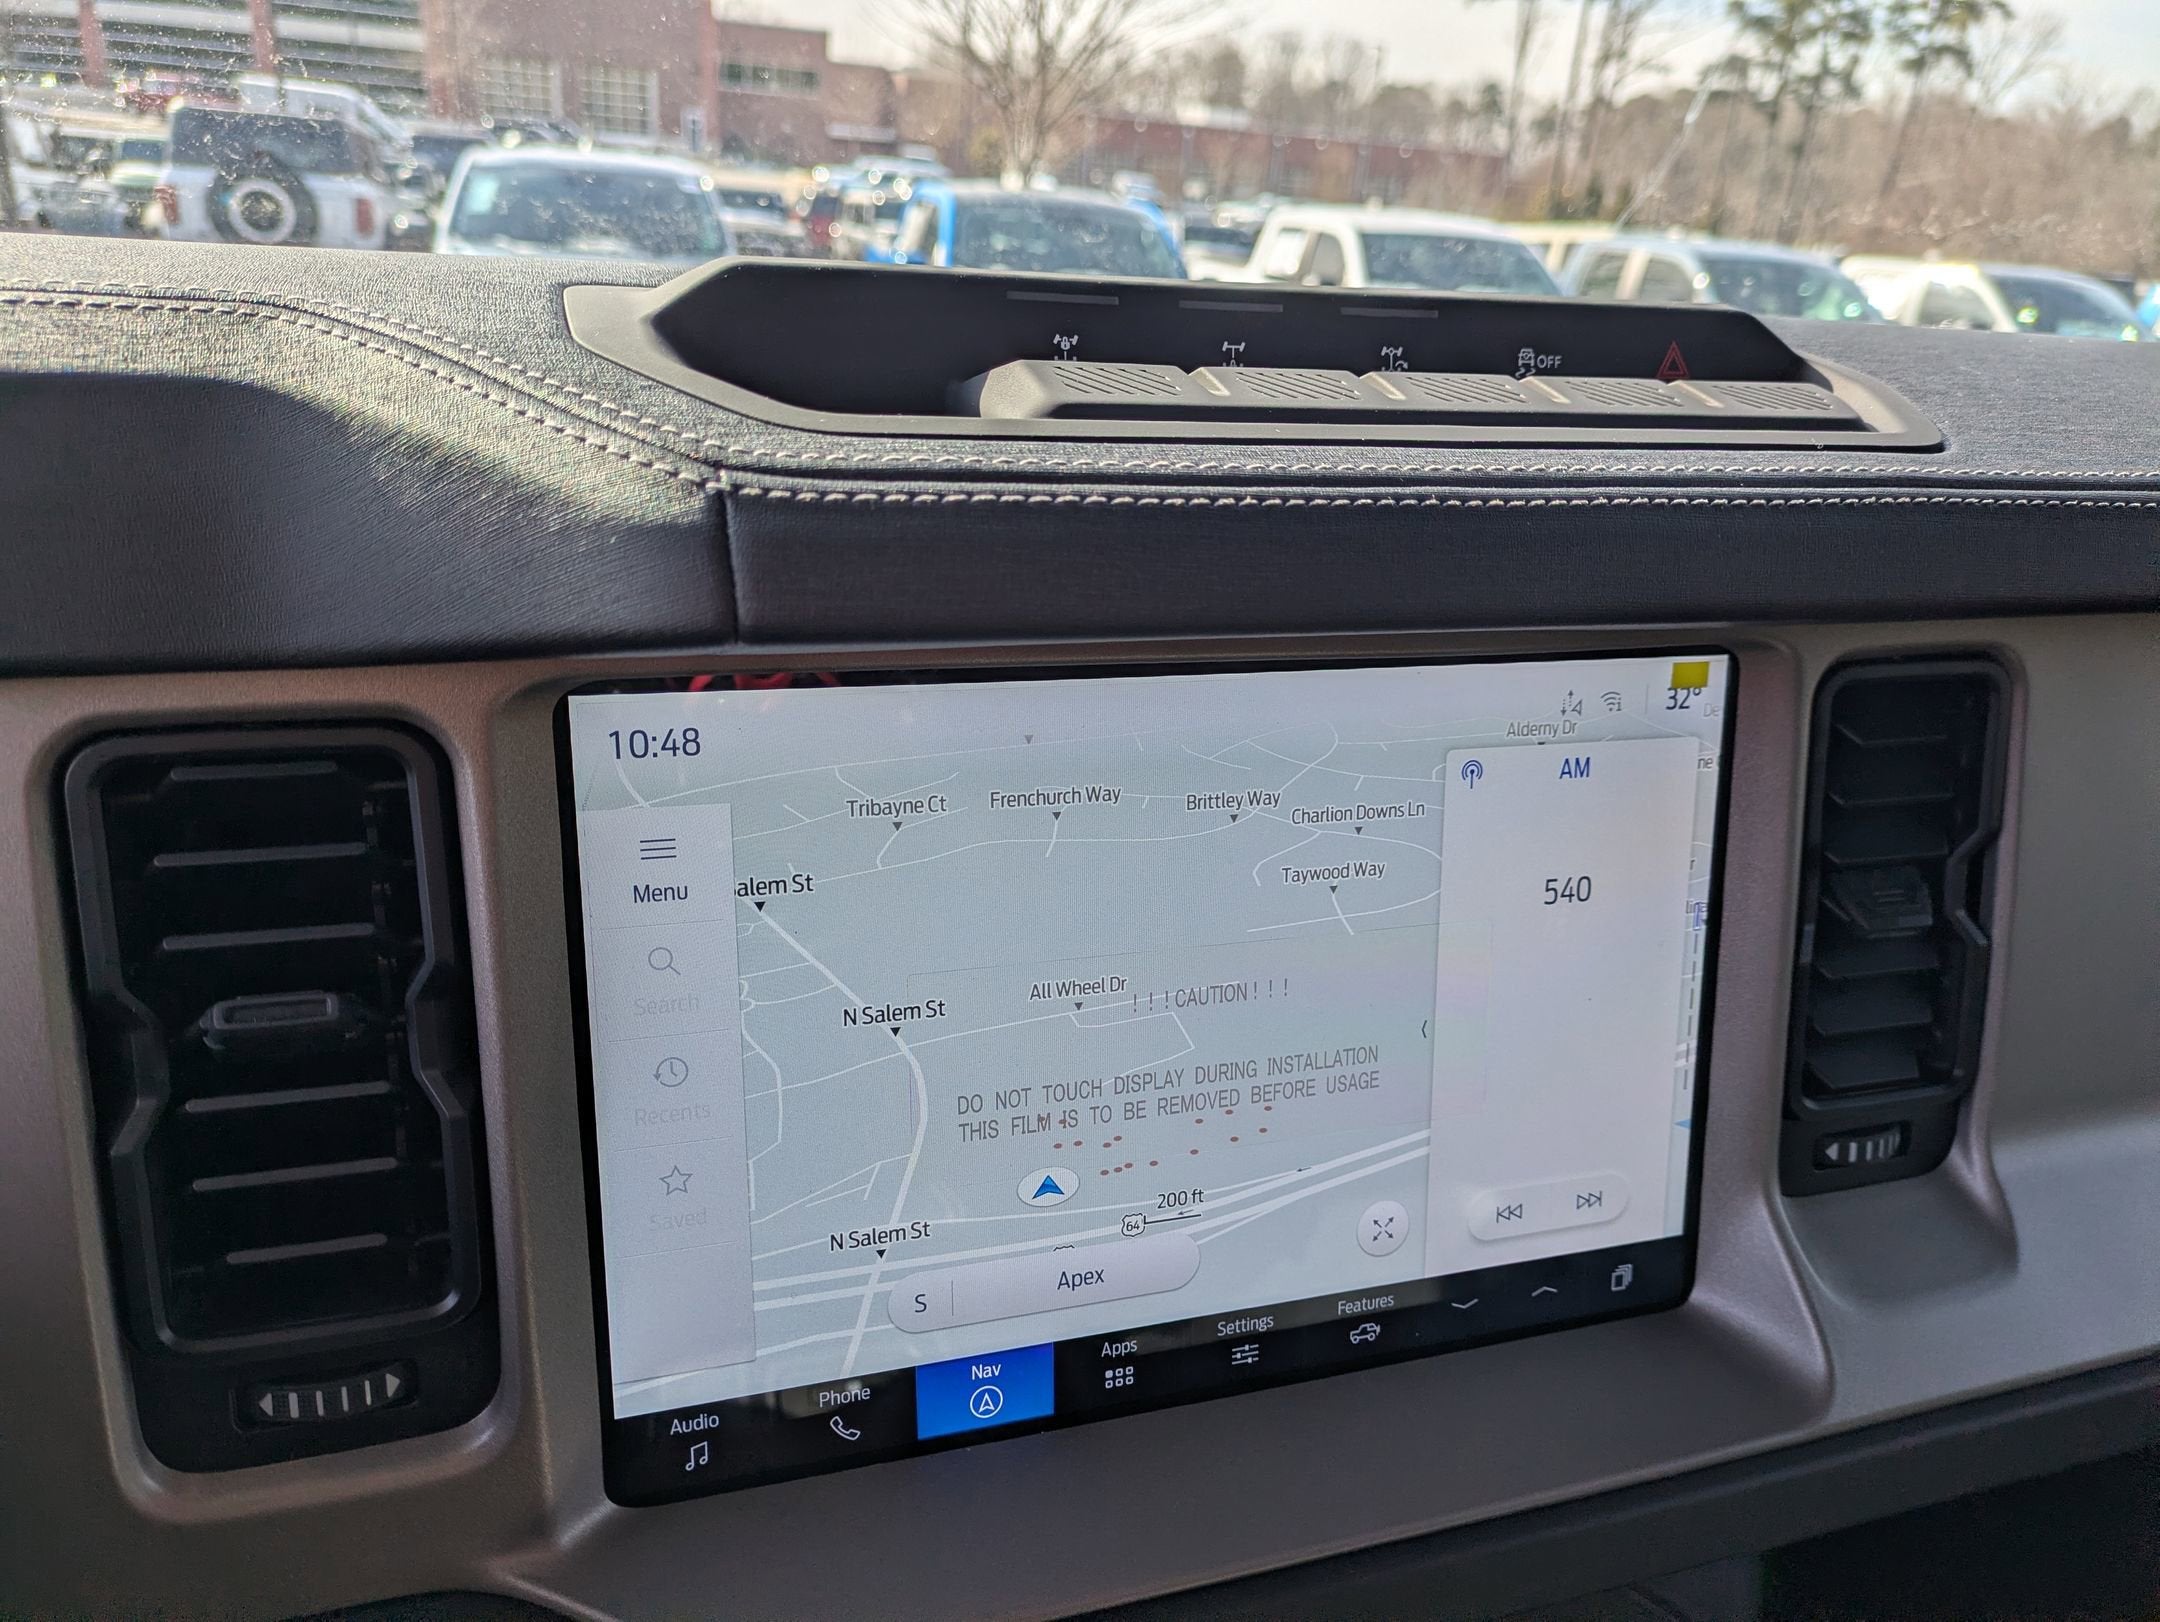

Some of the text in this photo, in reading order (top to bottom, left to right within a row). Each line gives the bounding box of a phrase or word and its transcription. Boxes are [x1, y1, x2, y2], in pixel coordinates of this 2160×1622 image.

[1536, 355, 1562, 369] OFF
[1506, 719, 1578, 739] Alderny Dr
[608, 727, 701, 760] 10:48
[1559, 756, 1591, 779] AM
[846, 794, 947, 819] Tribayne Ct
[990, 785, 1122, 809] Frenchurch Way
[1186, 790, 1281, 811] Brittley Way
[1291, 801, 1425, 825] Charlion Downs Ln
[734, 873, 815, 898] alem St
[1282, 861, 1386, 886] Taywood Way
[633, 883, 689, 904] Menu
[1544, 875, 1592, 905] 540
[1029, 976, 1128, 1001] All Wheel Dr
[842, 999, 947, 1026] N Salem St
[957, 1045, 1379, 1115] DO NOT TOUCH DISPLAY DURING INSTALLATION
[634, 1102, 711, 1127] Recents
[958, 1070, 1380, 1143] THIS FILM IS TO BE REMOVED BEFORE USAGE
[1156, 1188, 1205, 1209] 200 ft
[829, 1220, 931, 1252] N Salem St
[1125, 1219, 1141, 1232] 64
[1057, 1268, 1105, 1292] Apex
[914, 1294, 928, 1313] S
[1337, 1293, 1395, 1316] Features
[1217, 1313, 1274, 1337] Settings
[1101, 1338, 1138, 1358] Apps
[971, 1363, 1002, 1381] Nav
[819, 1386, 871, 1408] Phone
[669, 1413, 720, 1436] Audio
